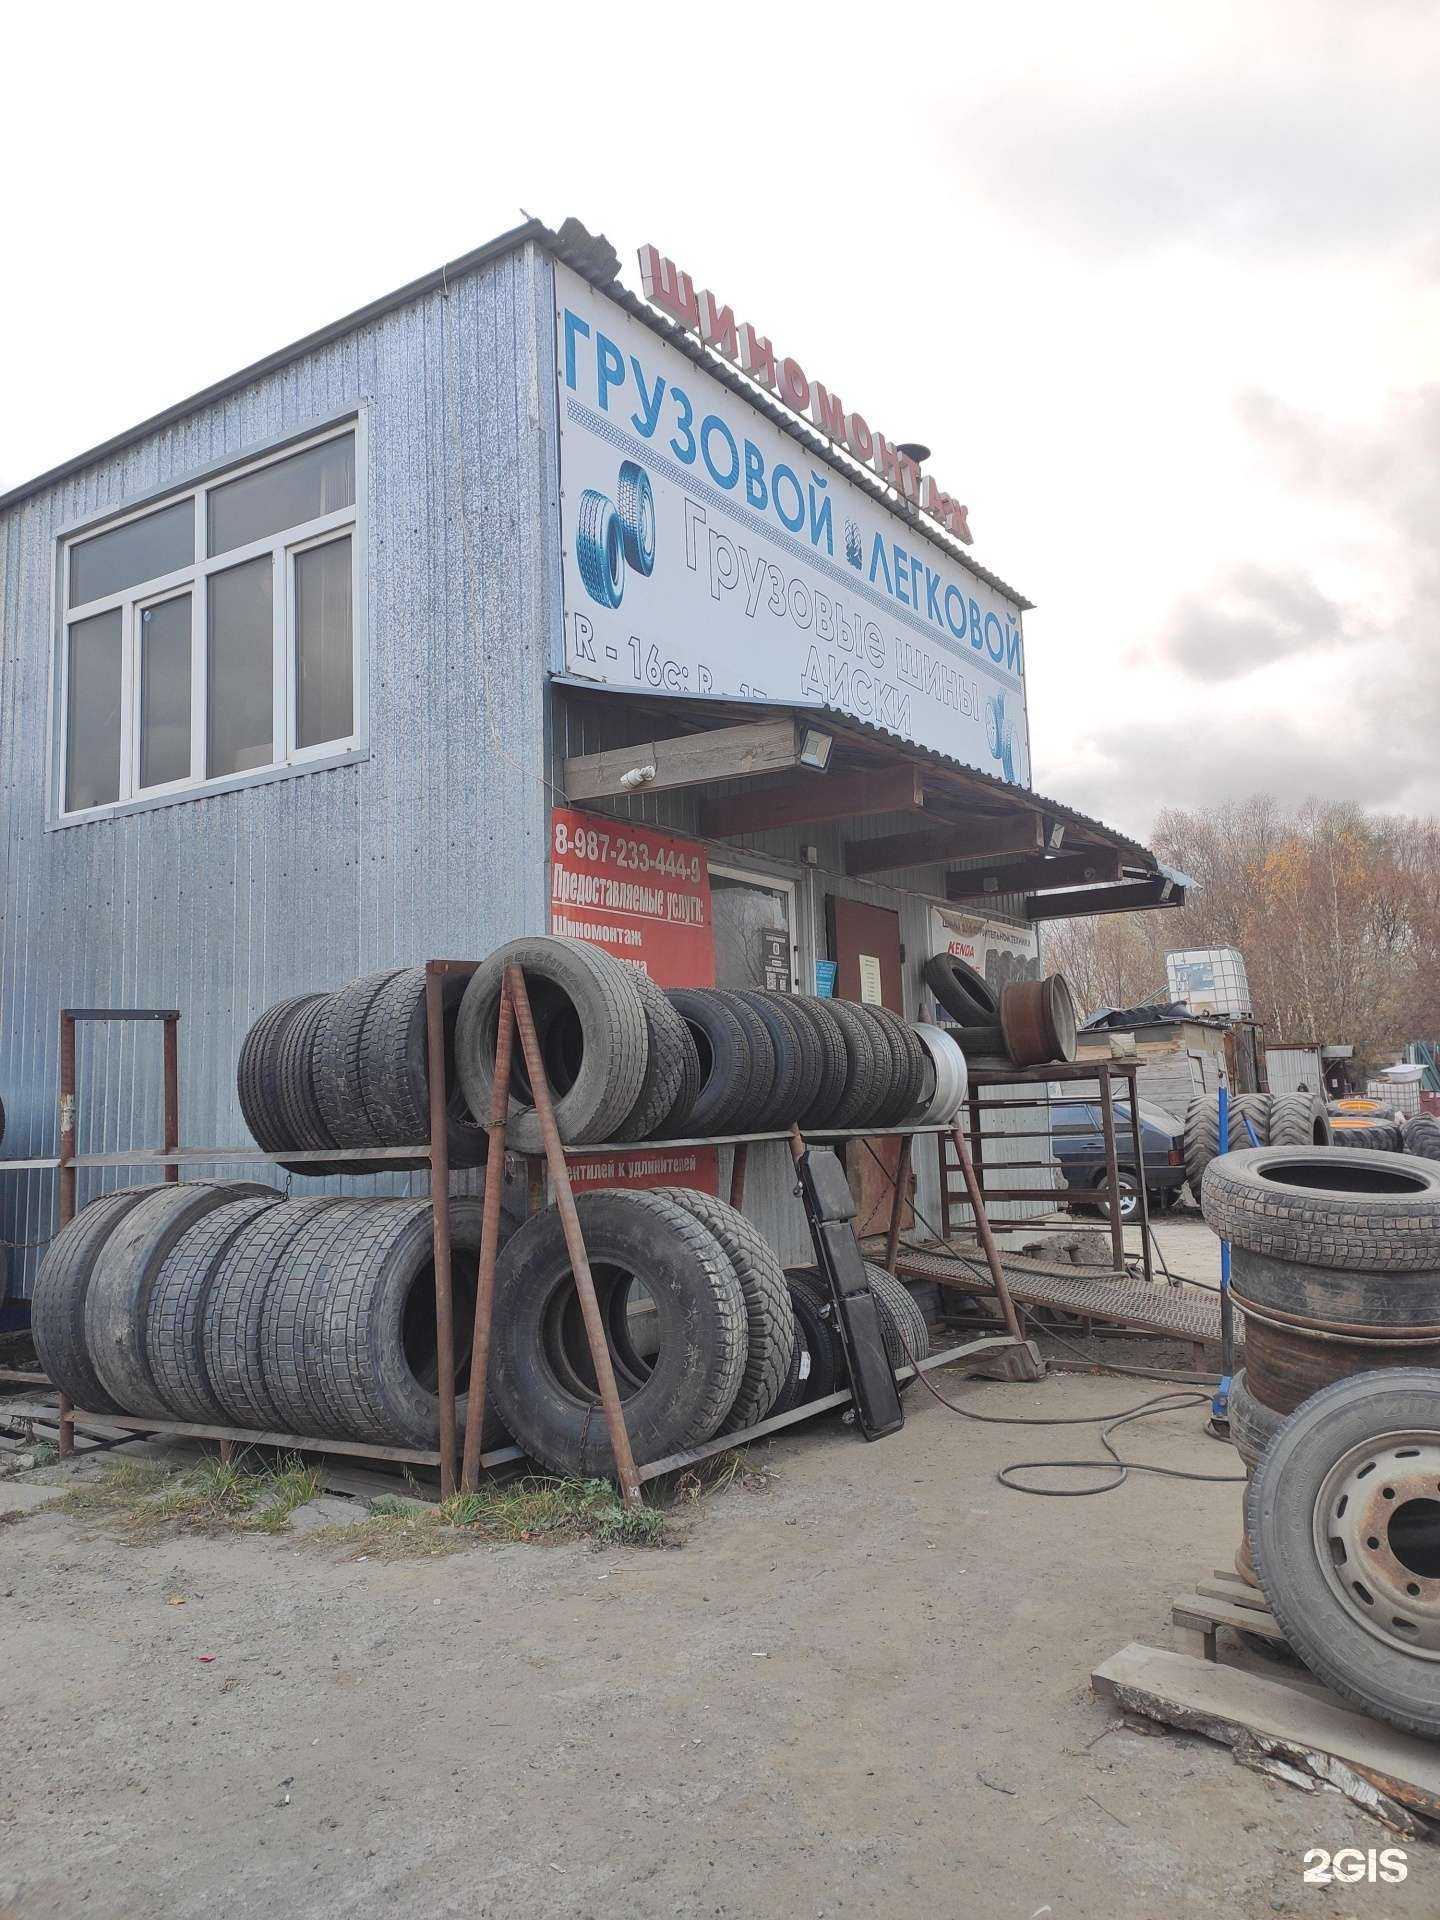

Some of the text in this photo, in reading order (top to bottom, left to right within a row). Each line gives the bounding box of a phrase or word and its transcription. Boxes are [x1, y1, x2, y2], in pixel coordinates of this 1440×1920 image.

[637, 243, 974, 545] ШИНОМОНТАЖ
[564, 308, 1021, 676] ГРУЗОВОЙ ЛЕГКОВОЙ
[683, 496, 886, 669] Грузовые
[575, 613, 597, 662] R
[555, 823, 700, 883] 8-987-233-444-9
[553, 863, 704, 924] Предоставляемые услуги:
[552, 915, 642, 946] Шиномонтаж
[948, 941, 975, 958] KENDA
